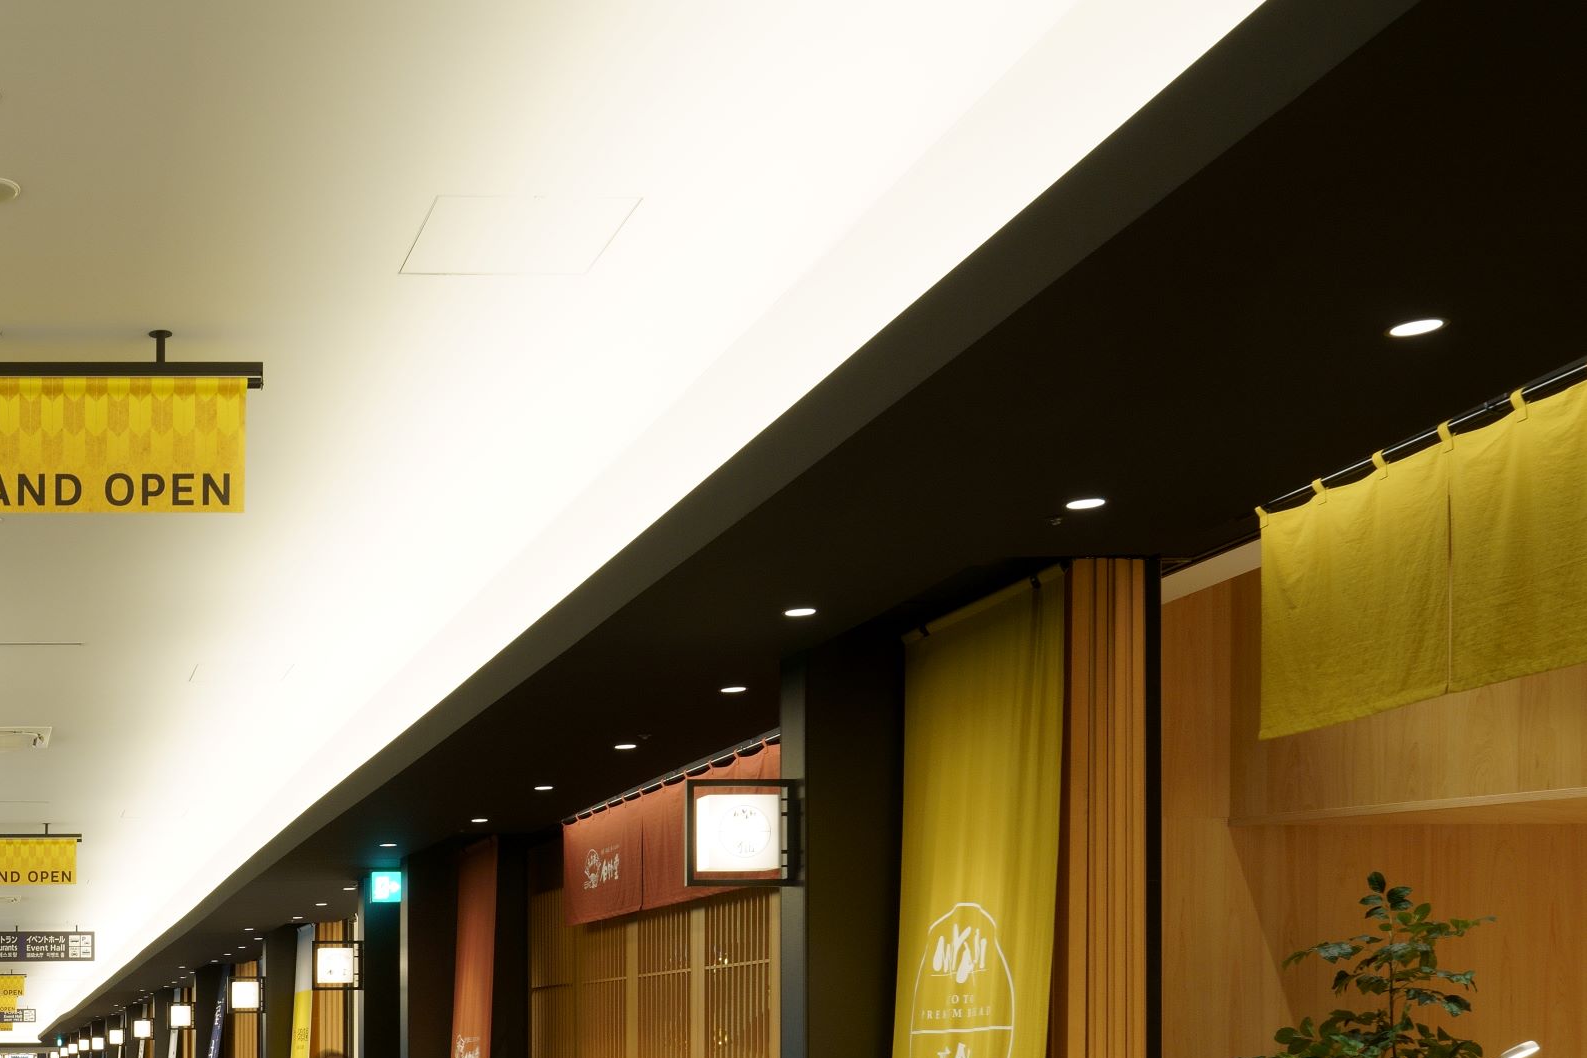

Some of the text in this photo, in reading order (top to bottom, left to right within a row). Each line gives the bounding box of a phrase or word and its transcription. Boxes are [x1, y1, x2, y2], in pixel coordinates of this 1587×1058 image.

[104, 472, 231, 507] OPEN
[27, 870, 72, 883] OPEN
[26, 935, 66, 944] イベントホール
[26, 944, 48, 952] Event
[50, 944, 66, 952] Hall
